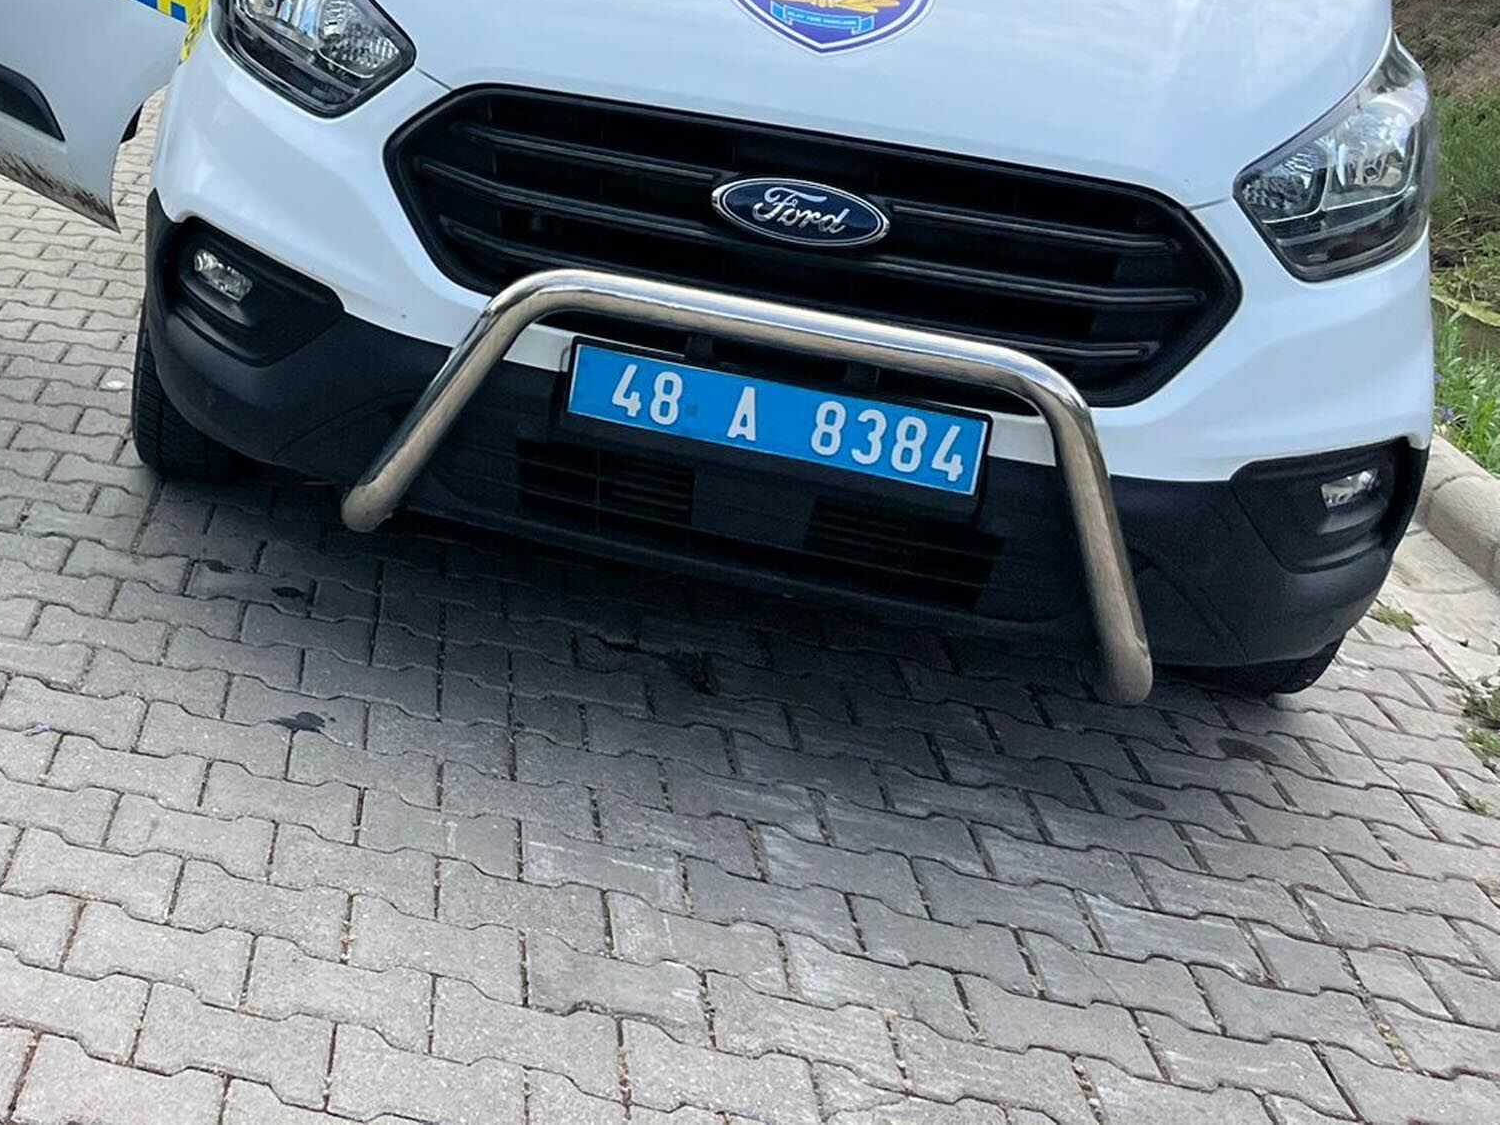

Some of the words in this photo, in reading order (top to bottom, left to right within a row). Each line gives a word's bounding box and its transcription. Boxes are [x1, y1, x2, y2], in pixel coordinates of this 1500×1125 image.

[752, 186, 850, 234] Ford
[611, 363, 684, 427] 48
[726, 386, 758, 442] A
[809, 400, 965, 483] 8384
